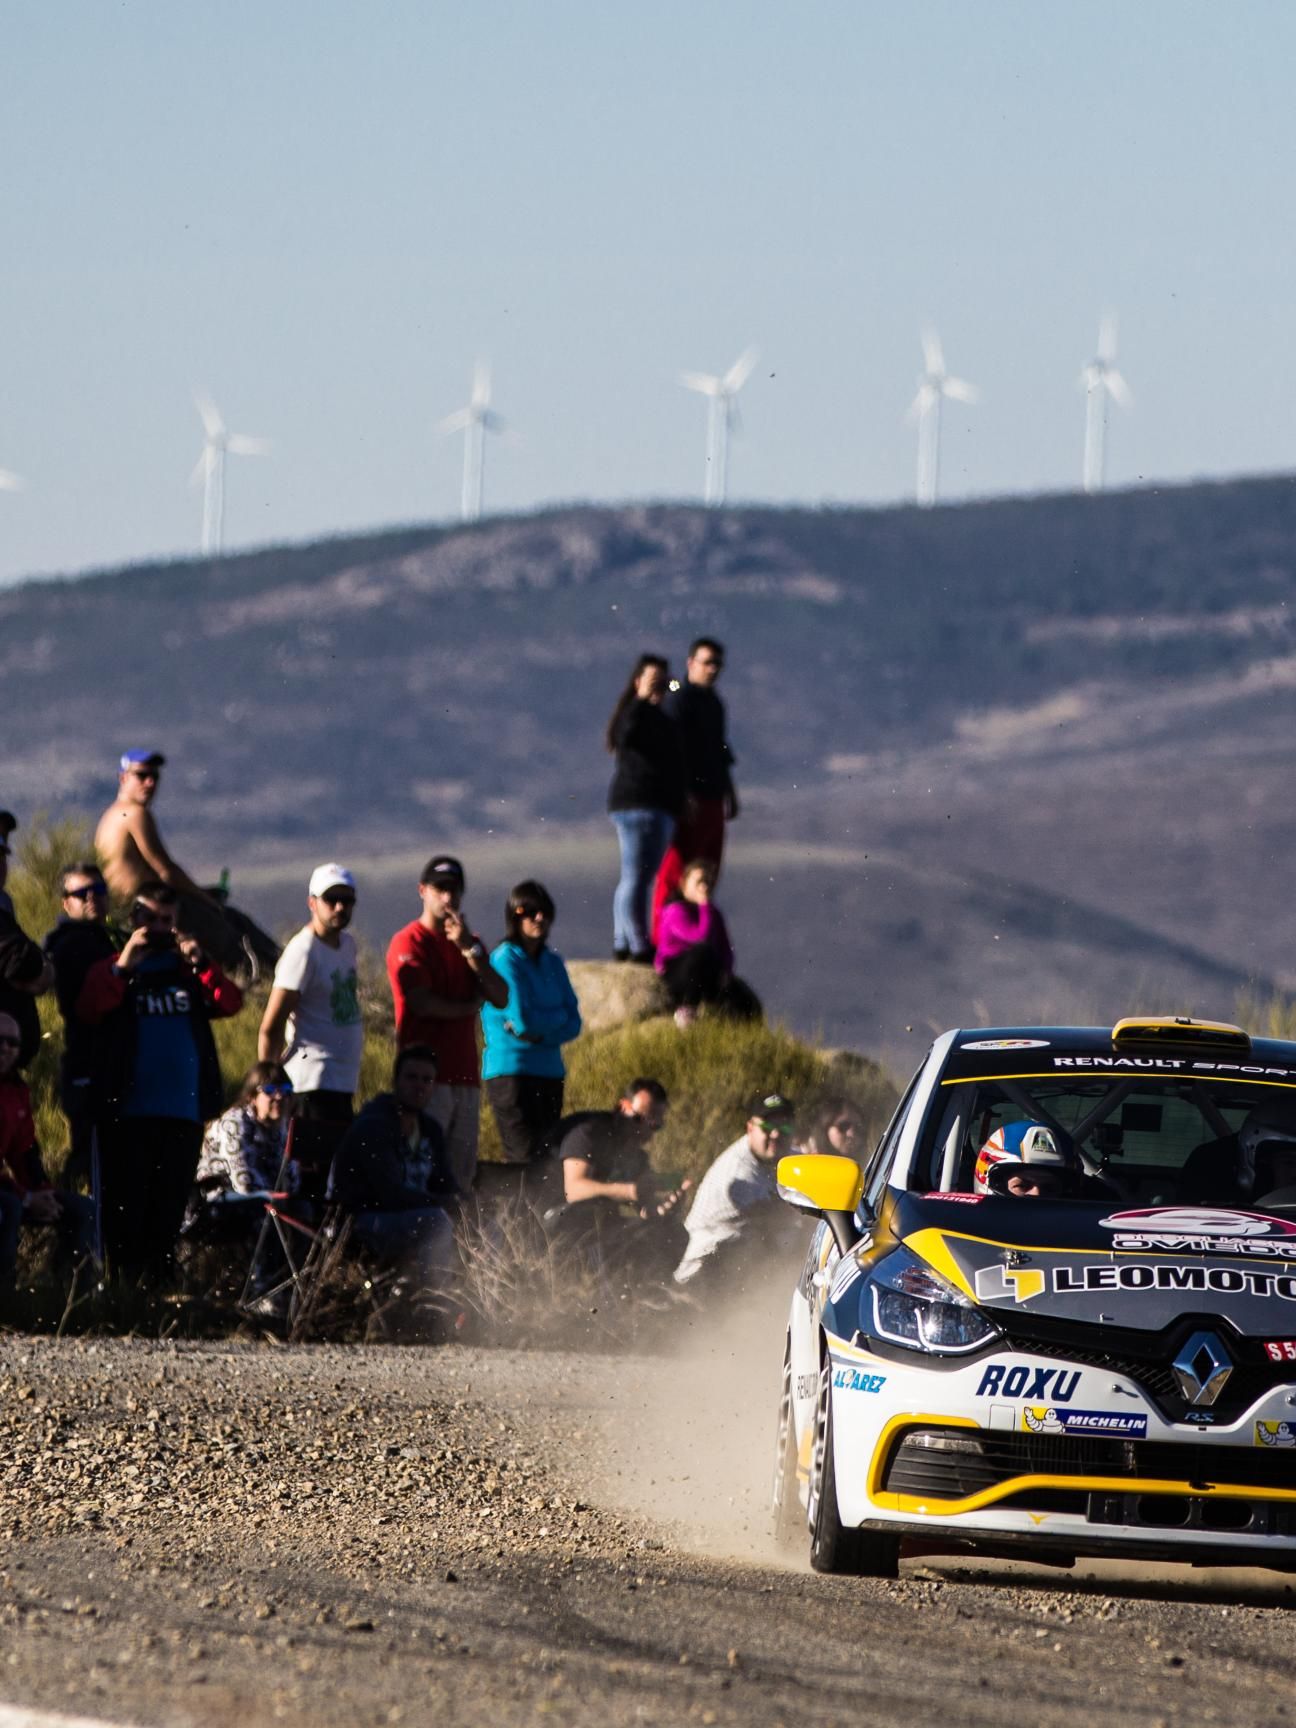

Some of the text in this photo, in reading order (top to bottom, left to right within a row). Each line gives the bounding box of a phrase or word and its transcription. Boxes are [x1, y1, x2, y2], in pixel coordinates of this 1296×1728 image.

[1053, 1056, 1186, 1069] RENAULT
[1267, 1342, 1283, 1361] S
[976, 1365, 1082, 1402] ROXU
[1066, 1415, 1146, 1429] MICHELIN
